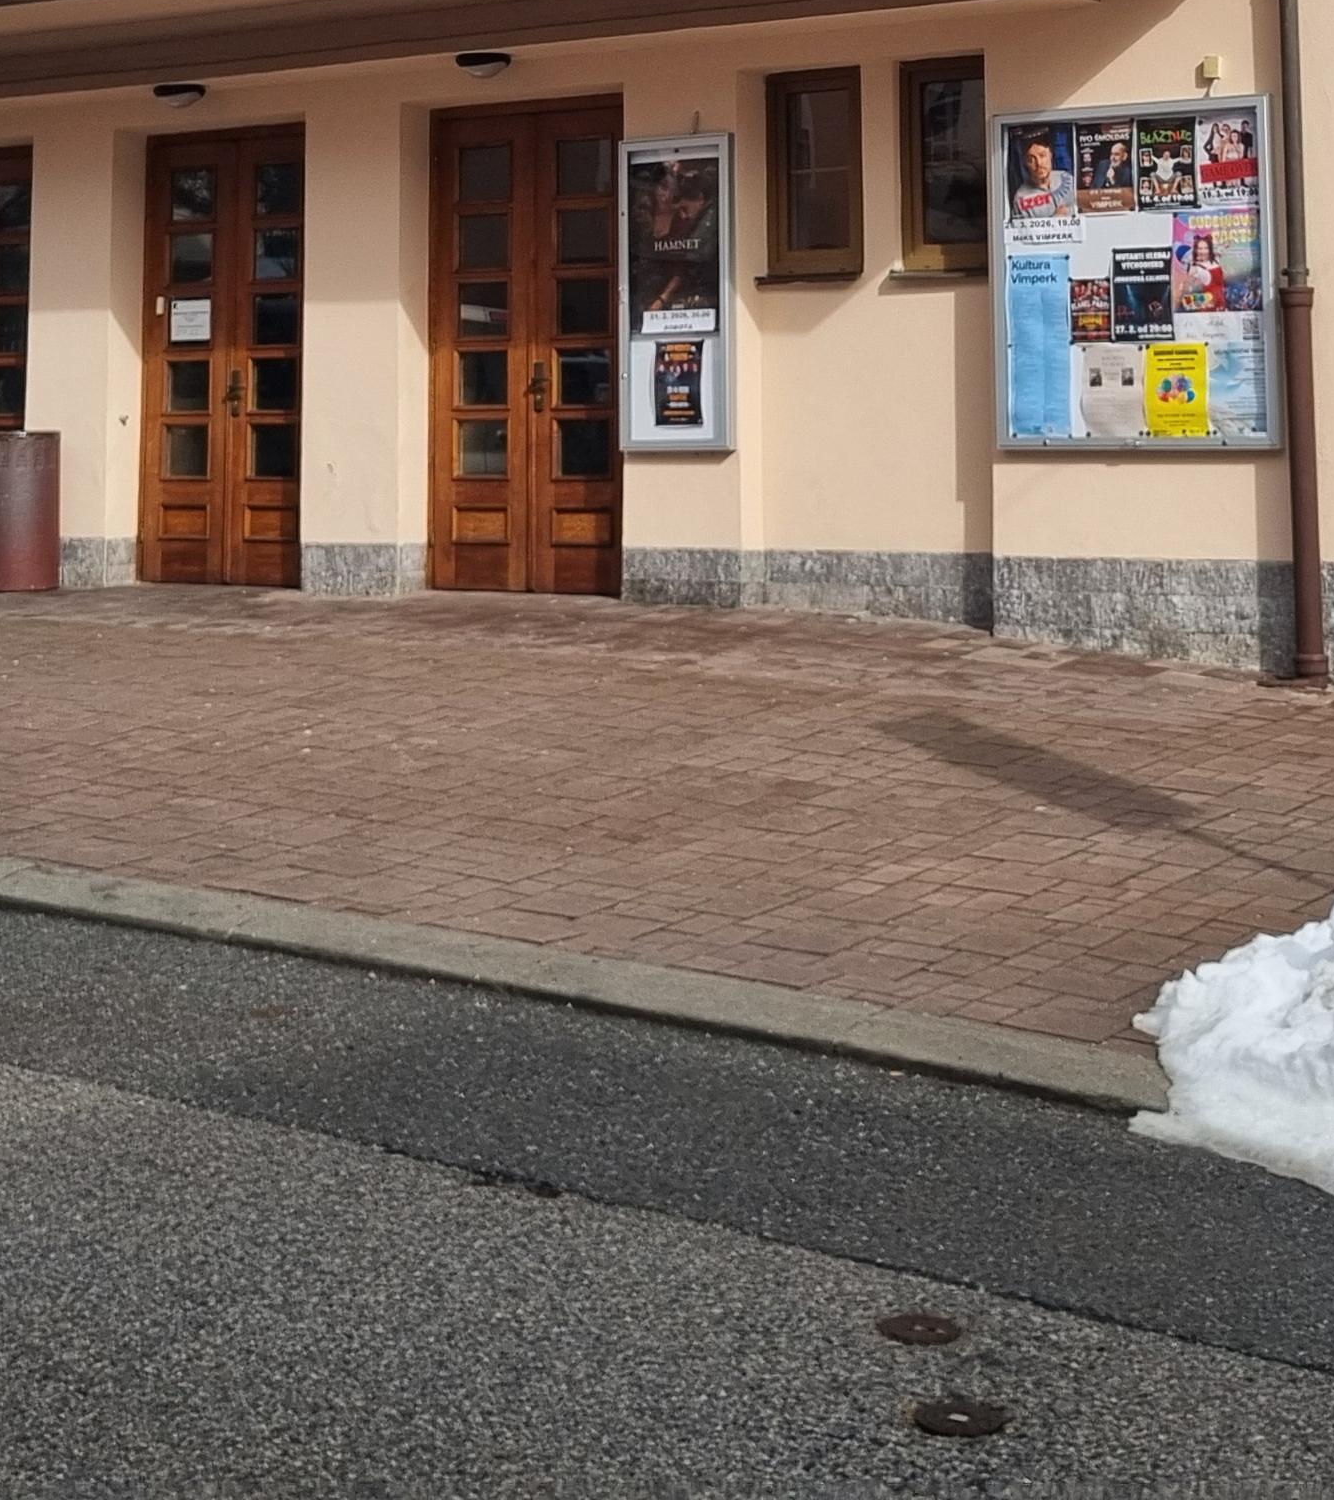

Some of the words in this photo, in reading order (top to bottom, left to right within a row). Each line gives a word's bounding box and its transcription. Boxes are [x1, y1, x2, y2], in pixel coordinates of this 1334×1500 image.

[653, 238, 701, 251] HAMNET
[1011, 259, 1051, 271] Kultura
[1011, 272, 1058, 285] Vimperk
